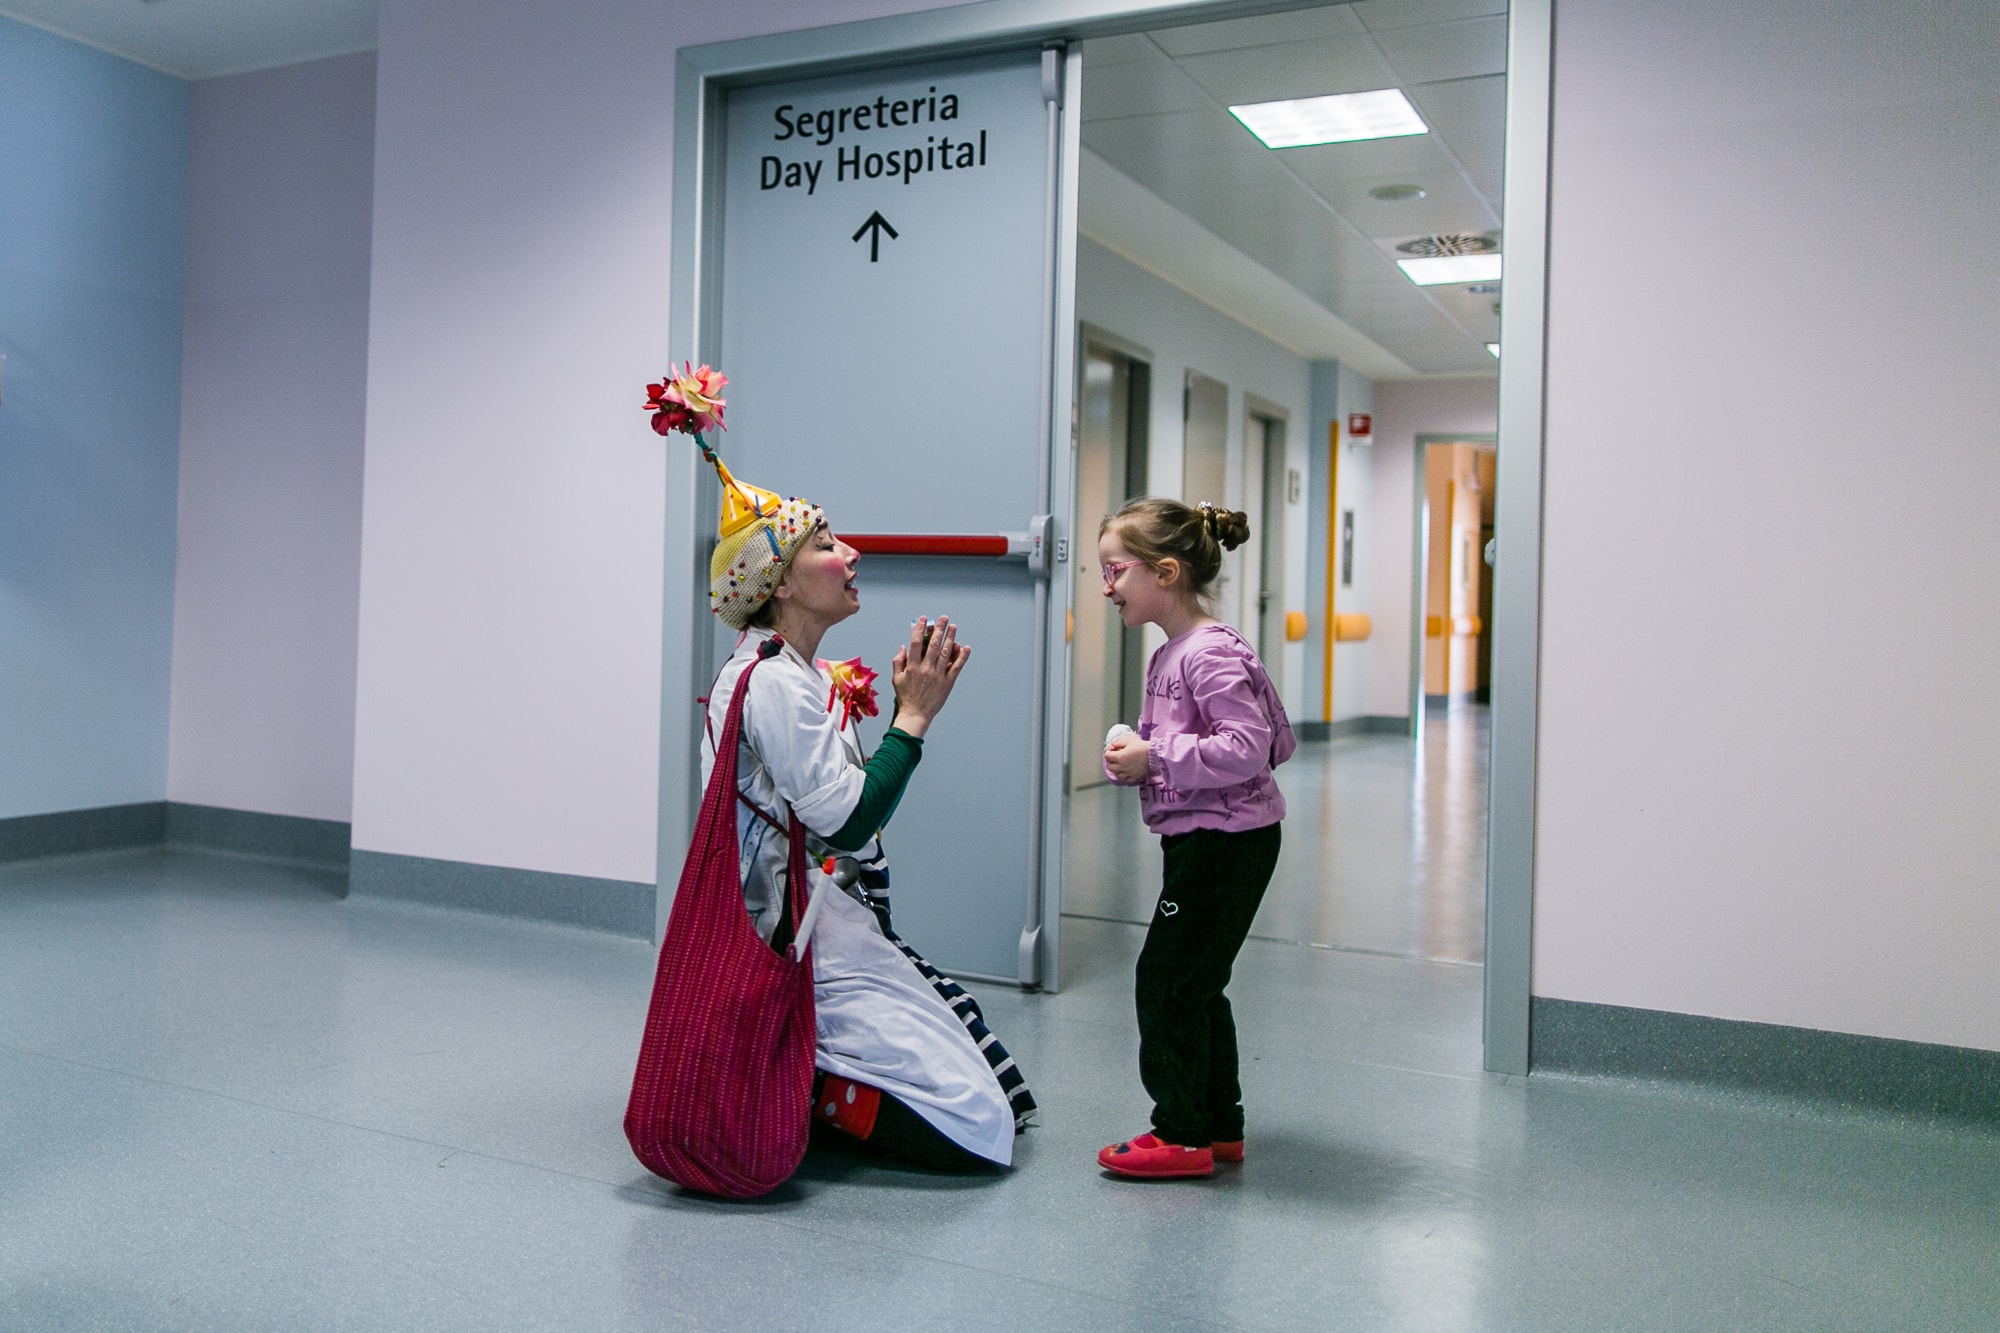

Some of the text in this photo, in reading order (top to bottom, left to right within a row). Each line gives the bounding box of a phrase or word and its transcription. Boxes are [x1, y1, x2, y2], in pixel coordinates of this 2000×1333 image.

[774, 86, 959, 146] Segreteria
[759, 129, 987, 196] Day Hospital
